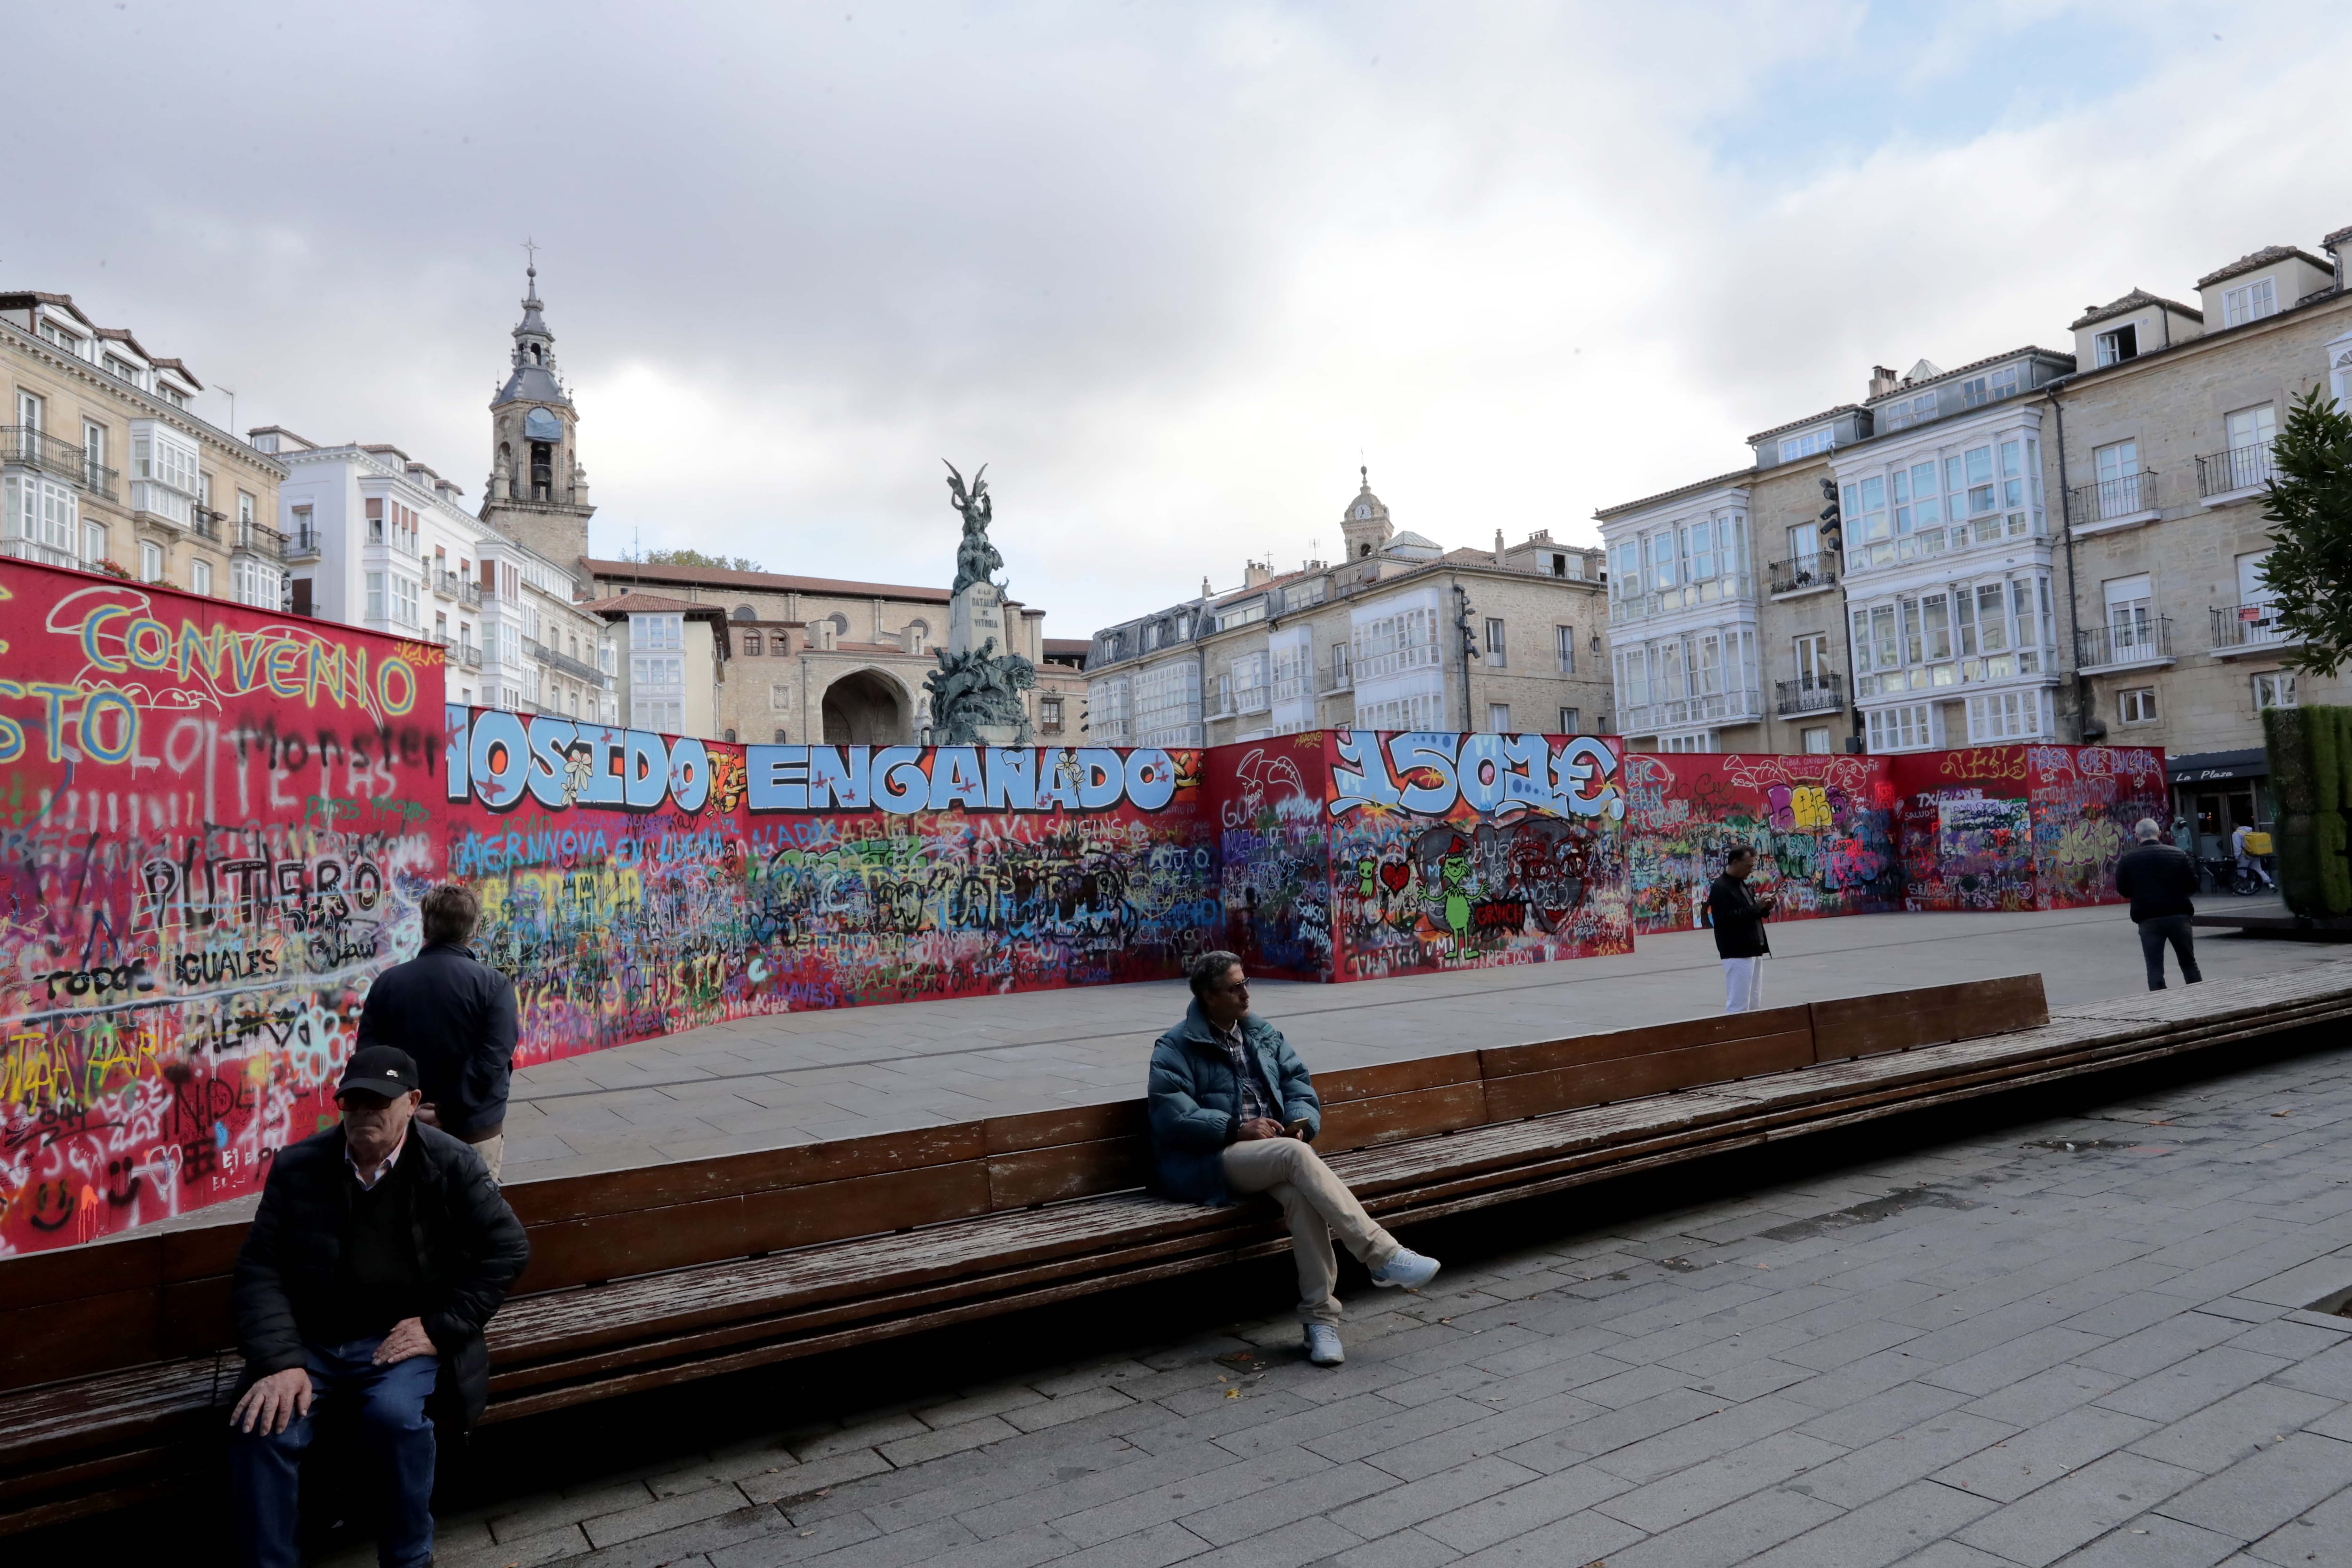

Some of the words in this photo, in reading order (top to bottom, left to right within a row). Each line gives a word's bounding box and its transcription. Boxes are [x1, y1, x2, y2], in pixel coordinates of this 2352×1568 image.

[971, 597, 998, 608] BATALLA
[974, 618, 998, 628] VITORIA
[80, 604, 416, 716] CONVENIO
[1803, 757, 1831, 765] CONVENIO
[1791, 766, 1821, 776] JUSTO
[2176, 773, 2192, 782] La
[2200, 769, 2234, 780] Plaza
[746, 744, 1175, 815] ENGAÑADO
[456, 828, 609, 874] AERNNOVA
[614, 837, 645, 869] EN
[660, 831, 726, 864] LUCHA
[1476, 902, 1524, 927] GRINCH
